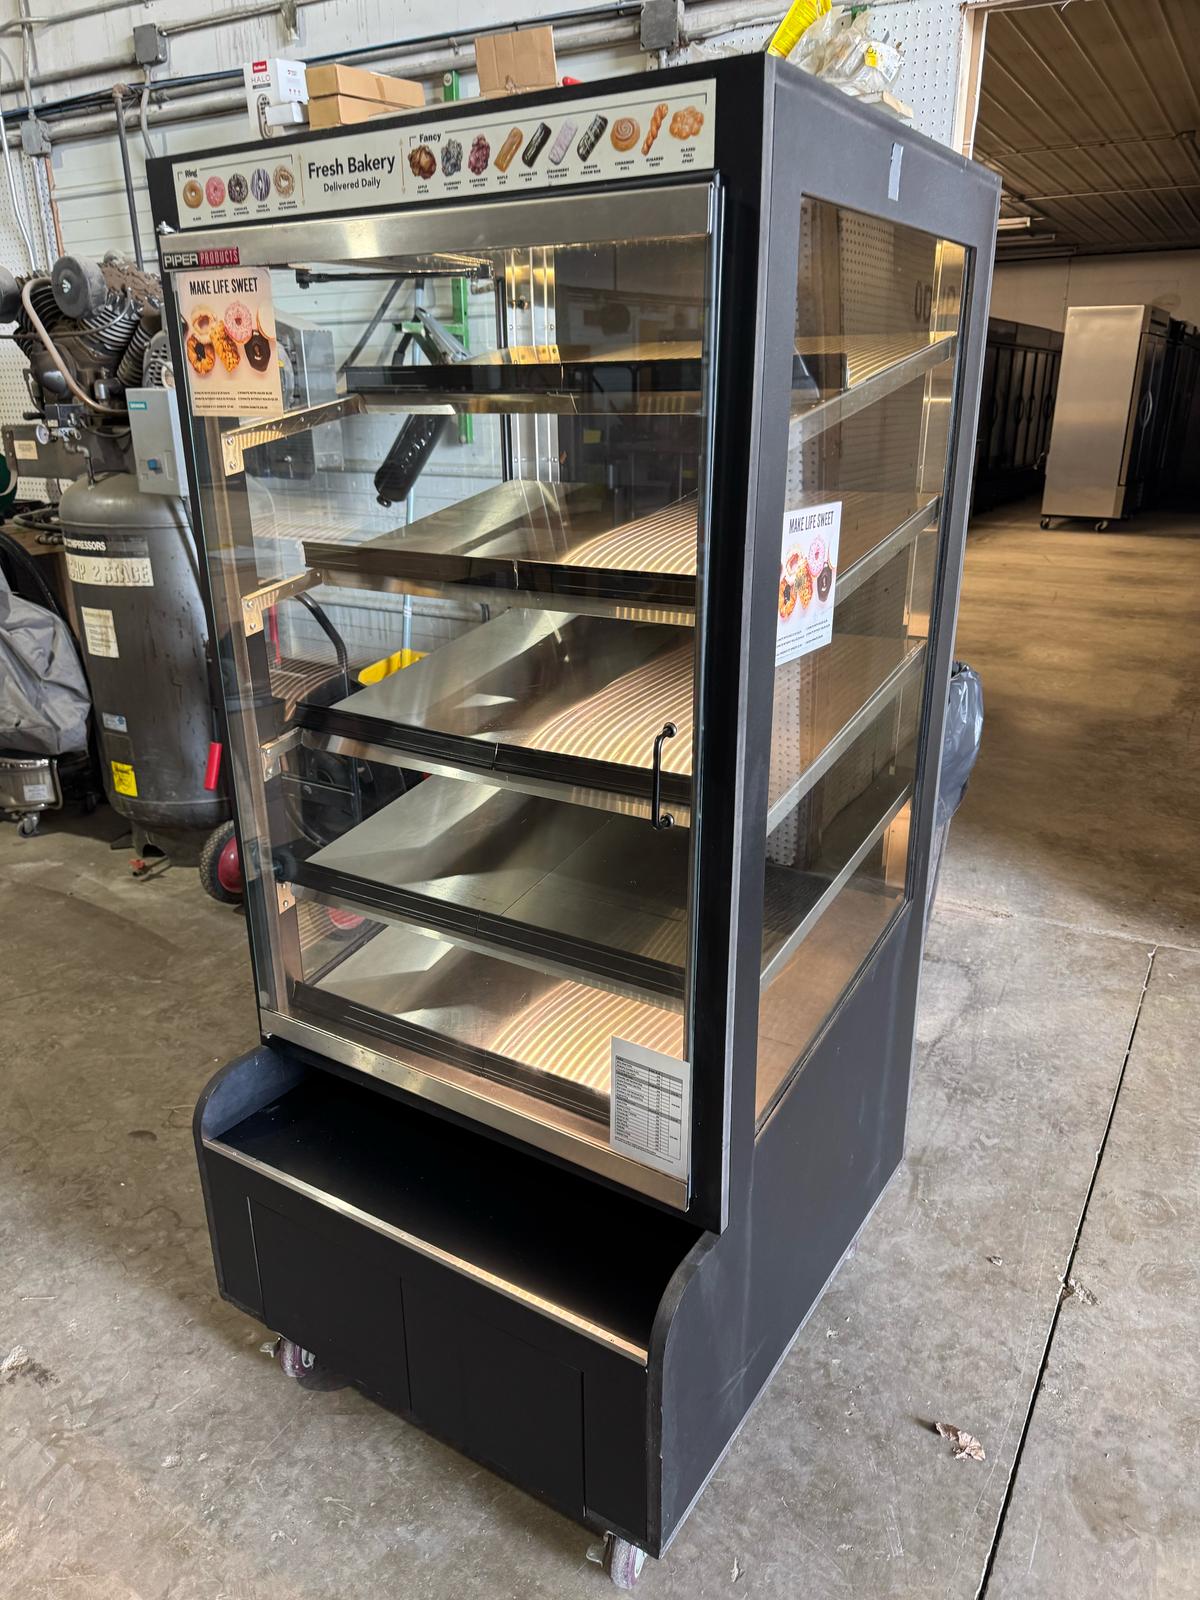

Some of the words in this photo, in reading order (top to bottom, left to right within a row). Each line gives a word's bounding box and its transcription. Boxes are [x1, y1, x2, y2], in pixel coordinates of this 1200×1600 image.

[252, 75, 271, 83] HALO
[419, 133, 442, 142] Fancy
[308, 157, 344, 179] Fresh
[347, 153, 396, 175] Bakery
[323, 181, 360, 193] Delivered
[361, 176, 381, 189] Daily
[164, 253, 199, 267] PIPER
[200, 249, 239, 265] PRODUCTS
[189, 281, 211, 296] MAKE
[212, 279, 230, 294] LIFE
[231, 277, 258, 293] SWEET
[789, 517, 804, 534] MAKE
[805, 514, 816, 530] LIFE
[817, 510, 834, 527] SWEET
[92, 565, 102, 582] 2
[103, 562, 151, 584] STAGE
